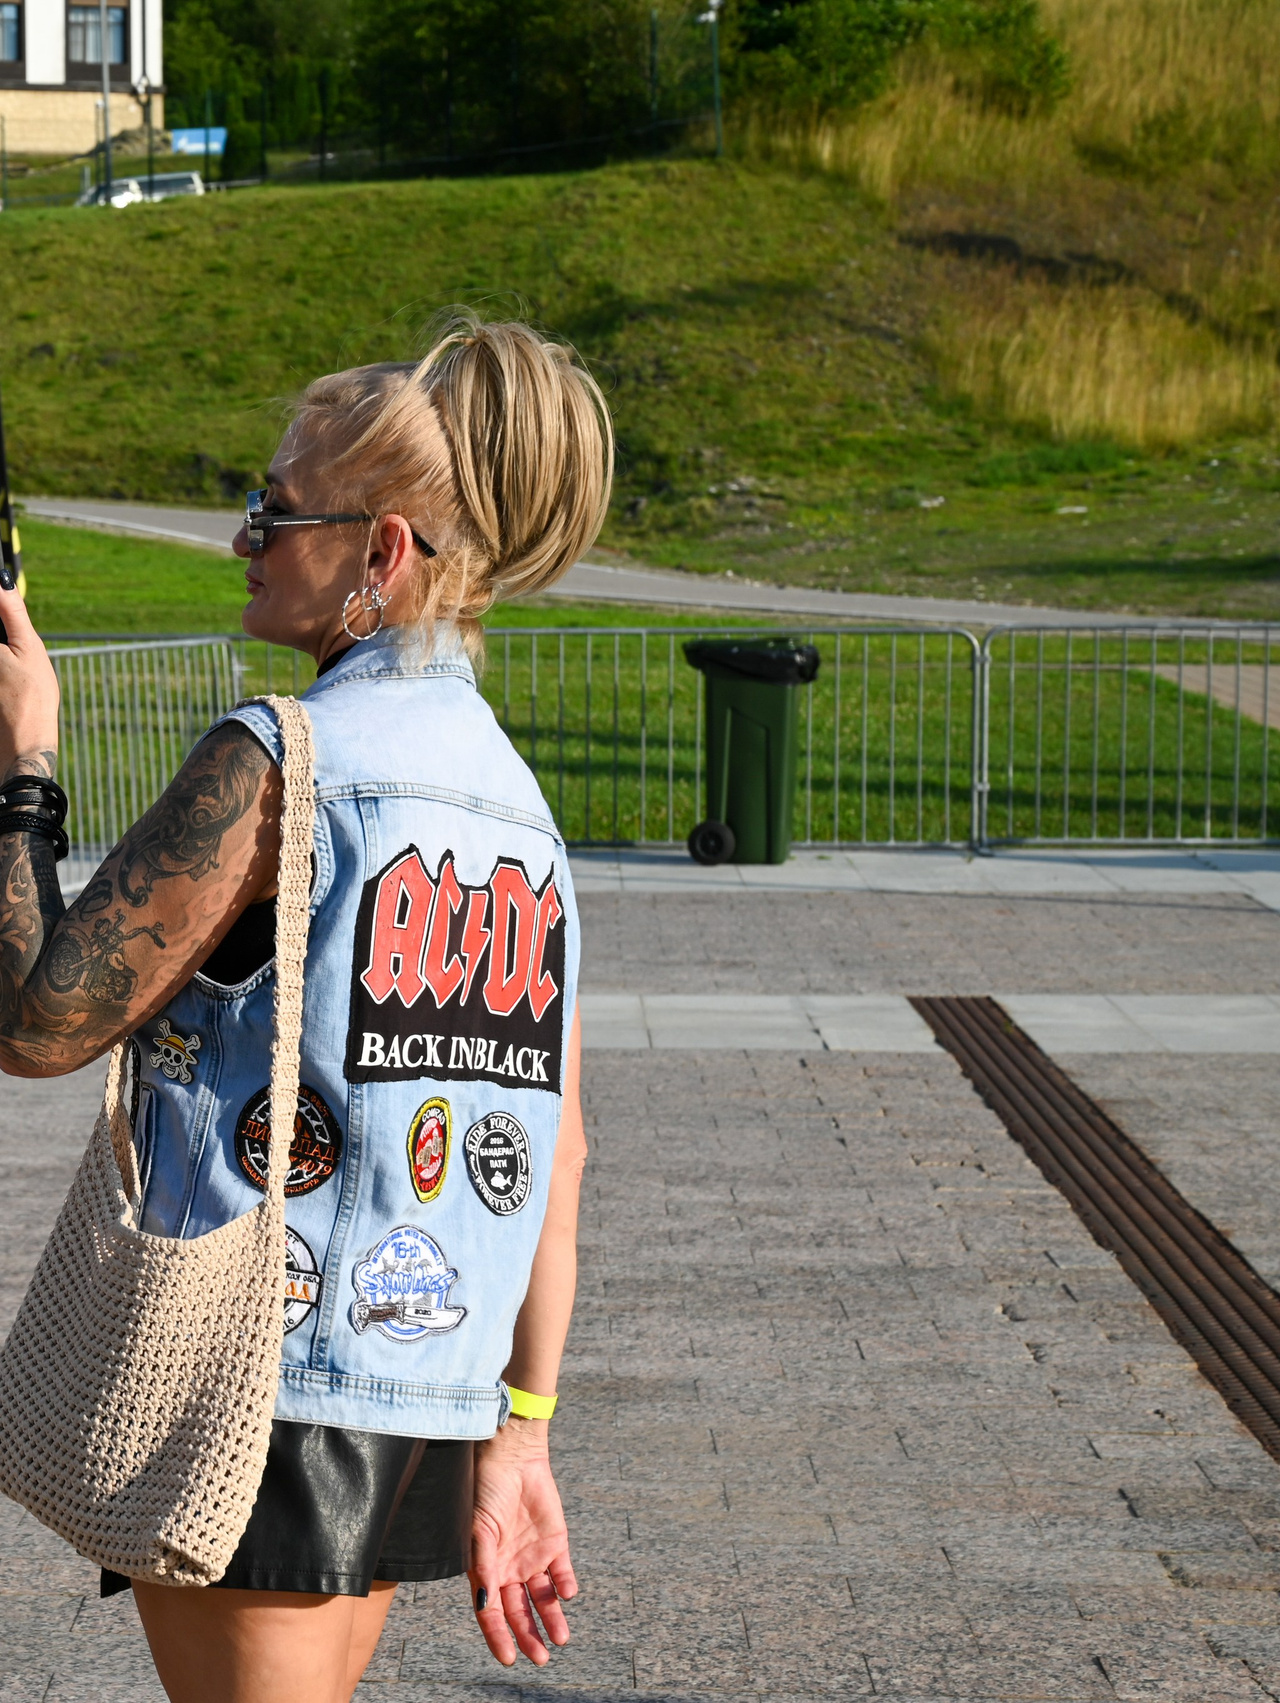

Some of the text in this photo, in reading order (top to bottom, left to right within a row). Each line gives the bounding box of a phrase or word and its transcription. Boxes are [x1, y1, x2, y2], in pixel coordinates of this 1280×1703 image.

[357, 1032, 445, 1068] BACK
[298, 1087, 309, 1098] ОК
[468, 1117, 525, 1154] RIDE FOREVER
[480, 1147, 514, 1157] БАНДЕРАС
[296, 1158, 333, 1176] 2019
[489, 1159, 508, 1168] ПАТИ
[512, 1173, 528, 1206] FREE
